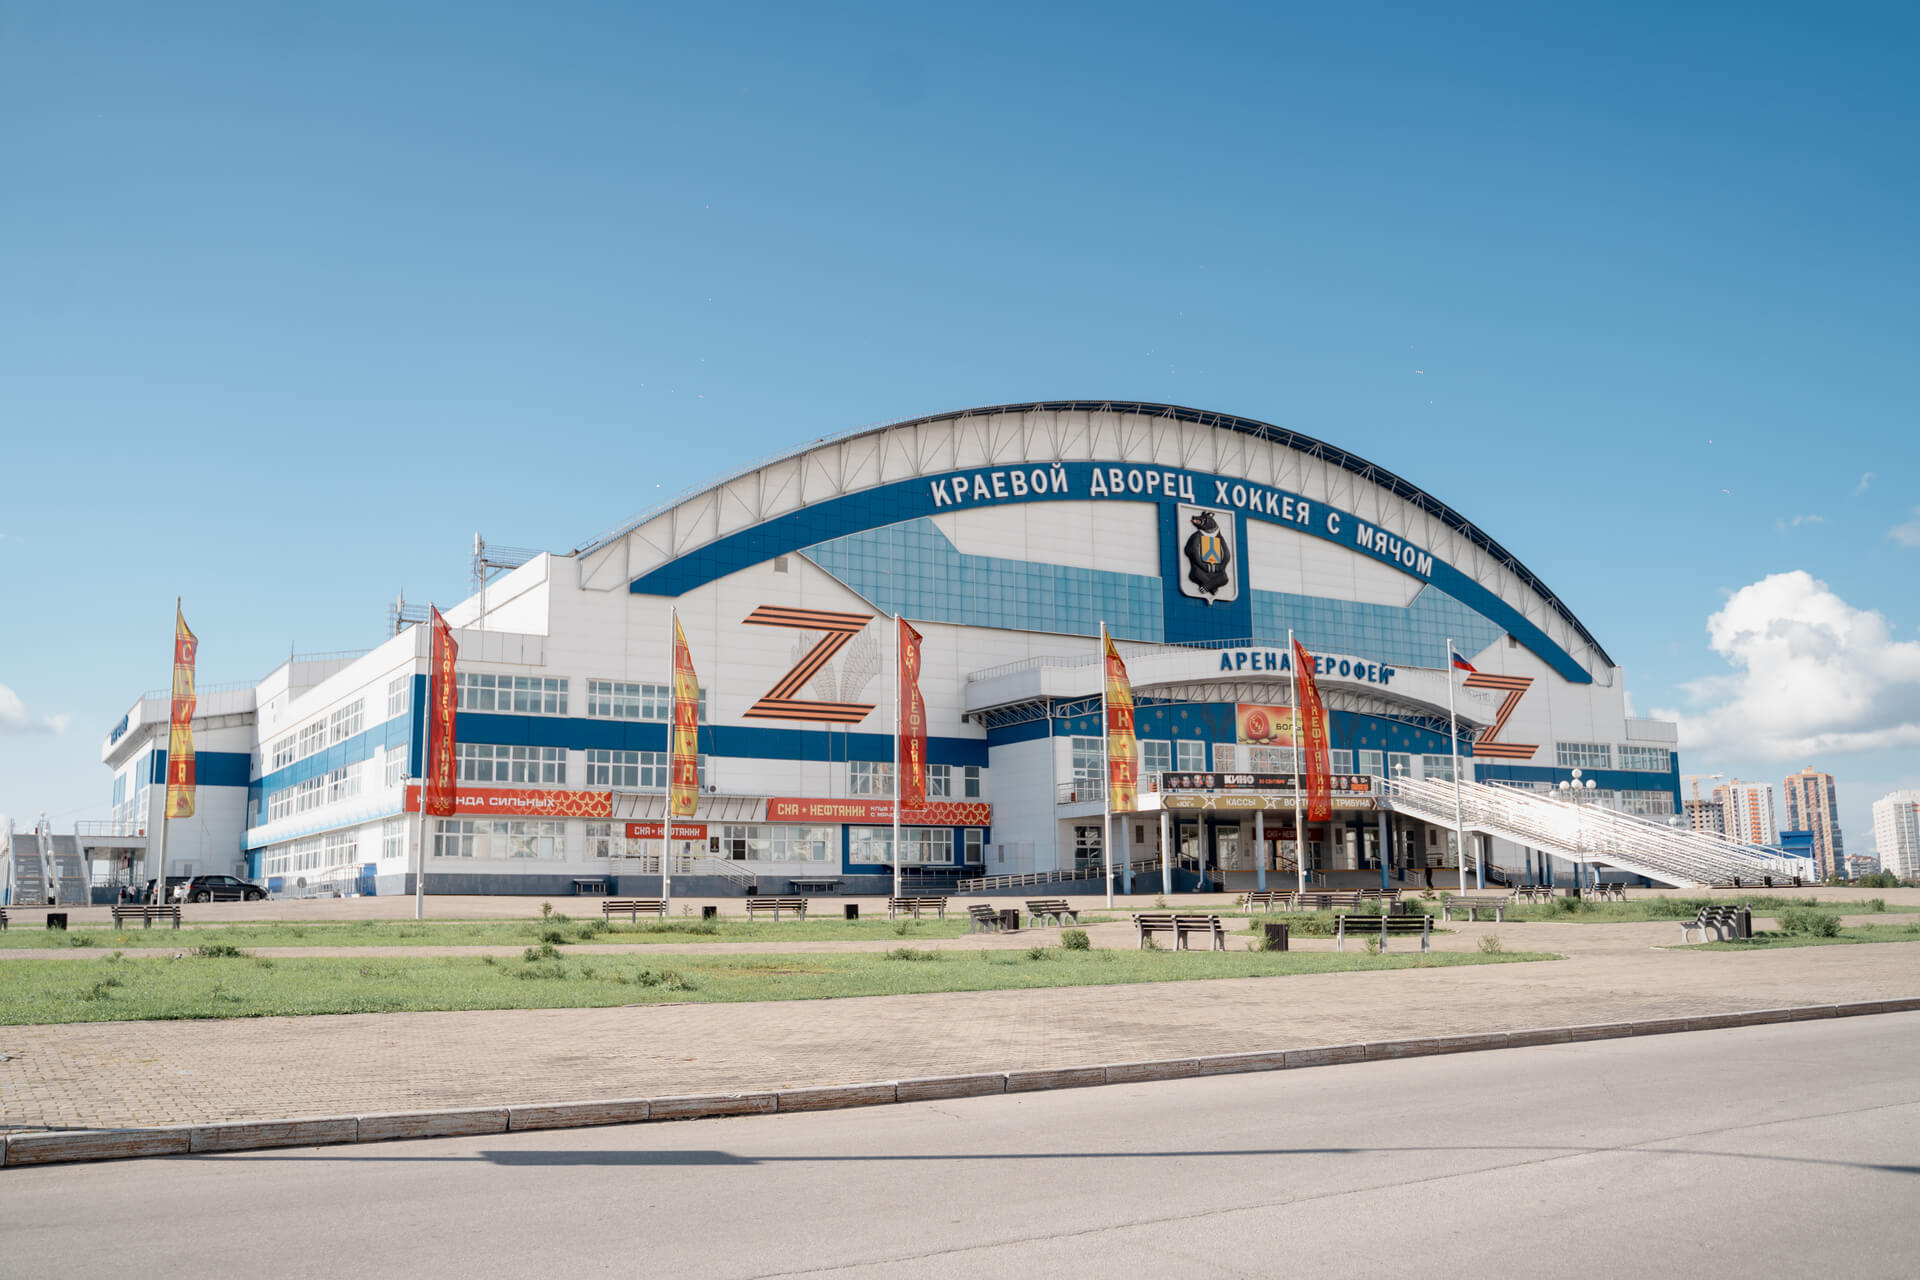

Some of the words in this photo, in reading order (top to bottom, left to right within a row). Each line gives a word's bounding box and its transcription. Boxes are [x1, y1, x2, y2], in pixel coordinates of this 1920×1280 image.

[930, 462, 1069, 508] КРАЕВОЙ
[1090, 467, 1196, 504] ДВОРЕЦ
[1215, 480, 1310, 525] ХОККЕЯ
[1326, 512, 1341, 535] С
[1356, 523, 1433, 578] МЯЧОМ
[1220, 652, 1291, 672] АРЕНА
[1310, 705, 1325, 797] НЕФТЯНИК
[1223, 774, 1255, 785] КИНО
[489, 796, 556, 808] СИЛЬНЫХ
[1225, 798, 1257, 807] КАССЫ
[1335, 799, 1371, 808] ТРИБУНА
[809, 804, 866, 817] НЕФТЯНИК
